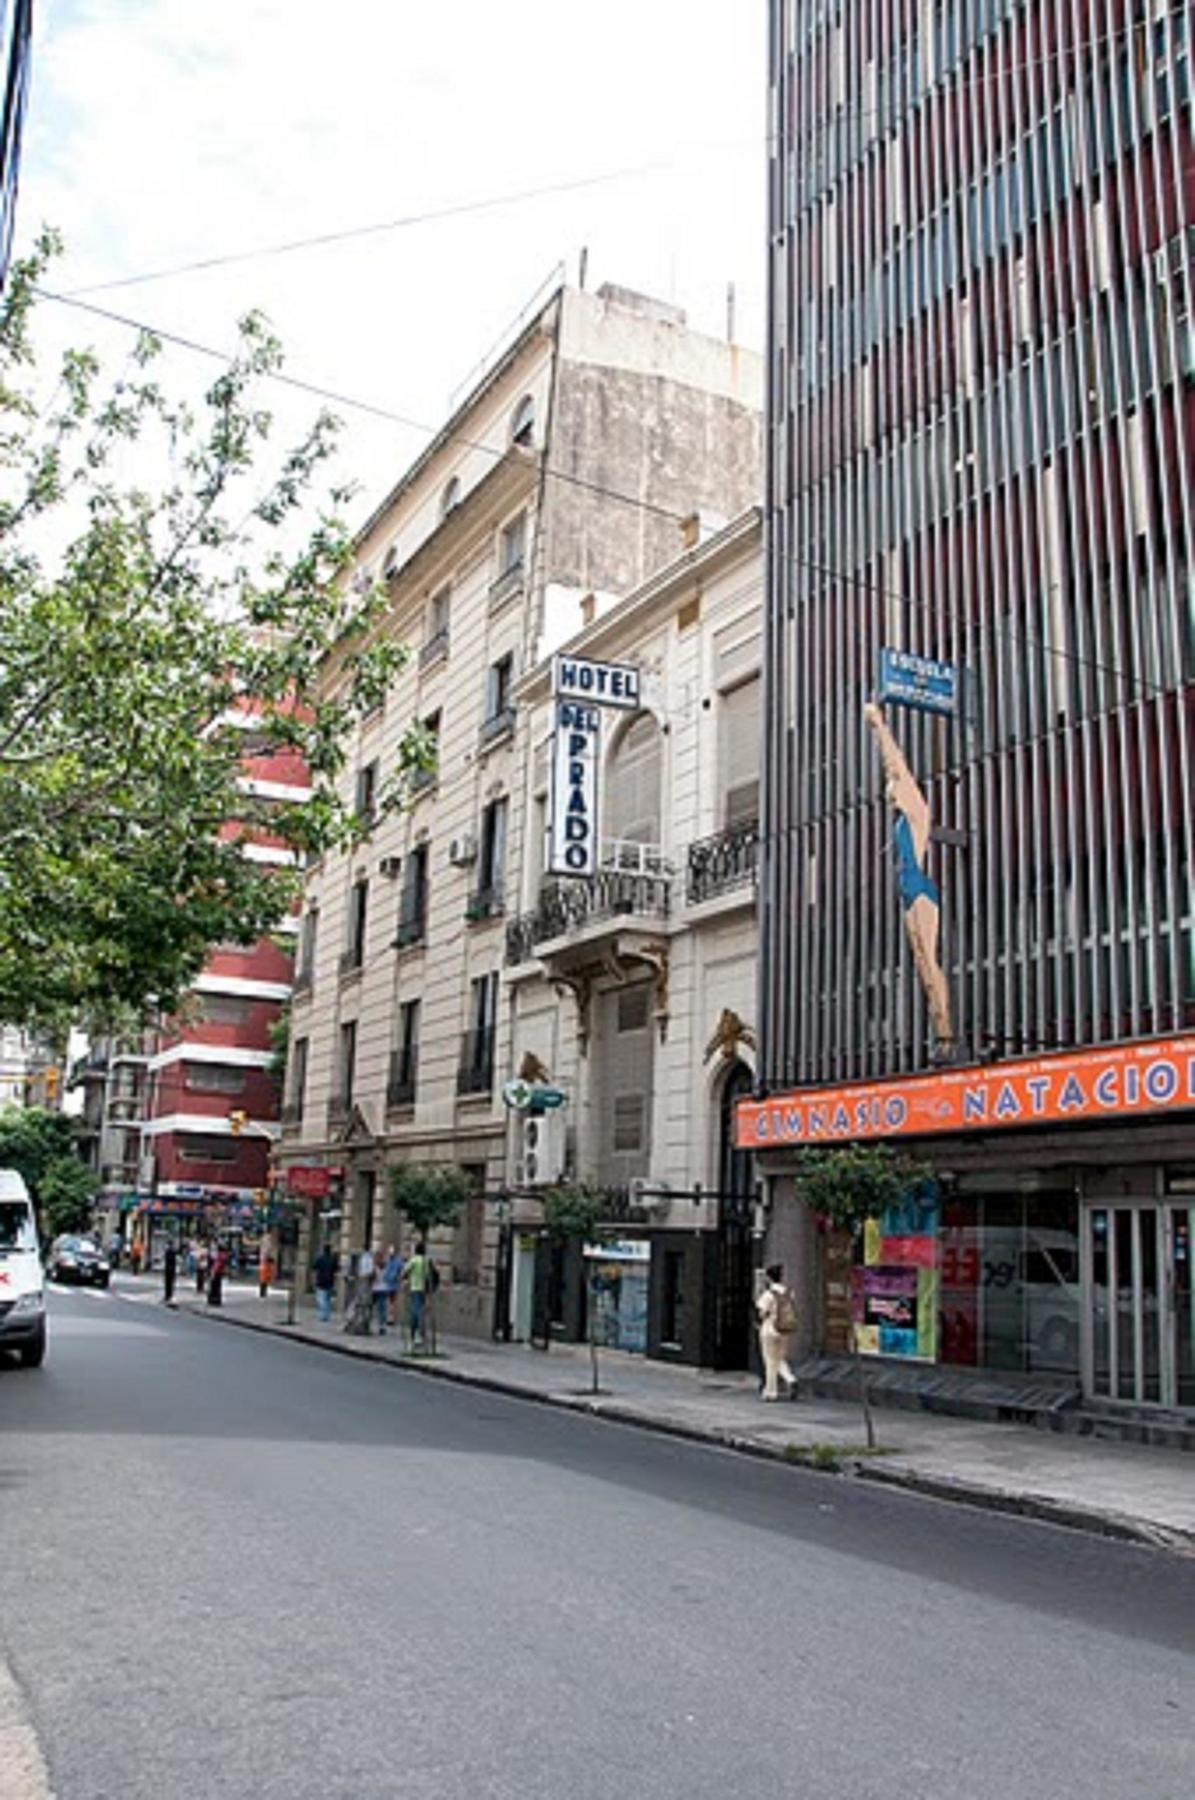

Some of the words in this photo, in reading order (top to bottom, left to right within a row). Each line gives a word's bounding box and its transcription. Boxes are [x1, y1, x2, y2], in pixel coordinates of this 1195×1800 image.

[561, 662, 637, 698] HOTEL
[559, 703, 599, 732] DEL
[564, 734, 589, 869] PRADO
